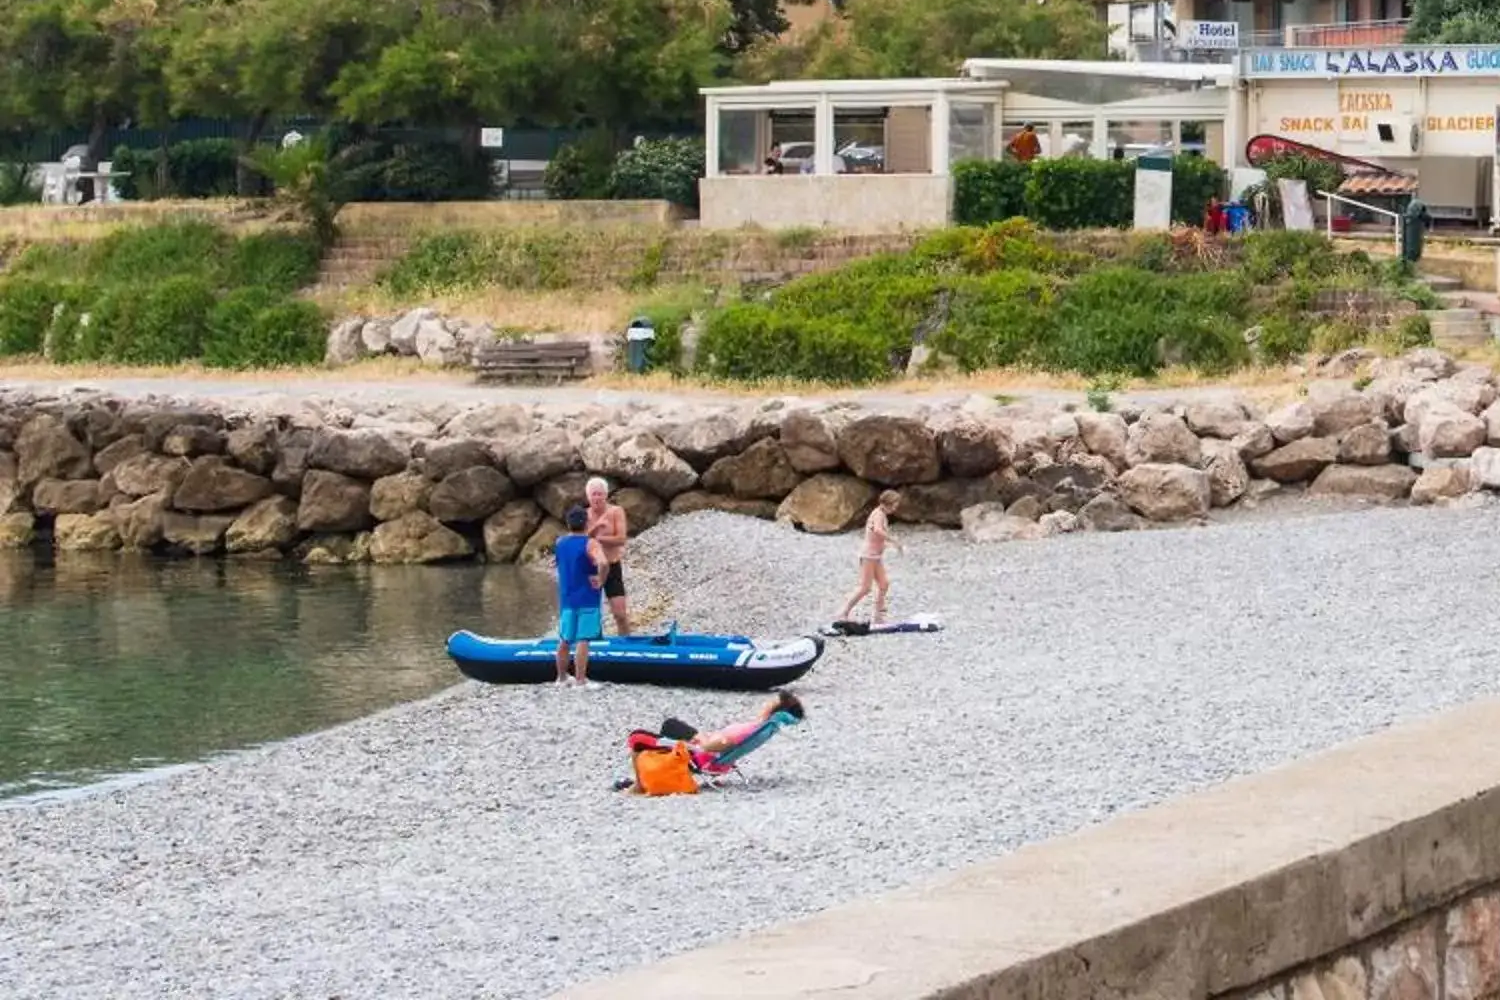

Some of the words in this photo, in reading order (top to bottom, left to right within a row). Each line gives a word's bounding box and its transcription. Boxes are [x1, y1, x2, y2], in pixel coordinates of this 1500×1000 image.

[1199, 23, 1235, 37] Hotel
[1279, 52, 1317, 72] SNACK
[1325, 49, 1459, 73] L'ALASKA
[1279, 116, 1335, 132] SNACK
[1426, 115, 1495, 131] GLACIER
